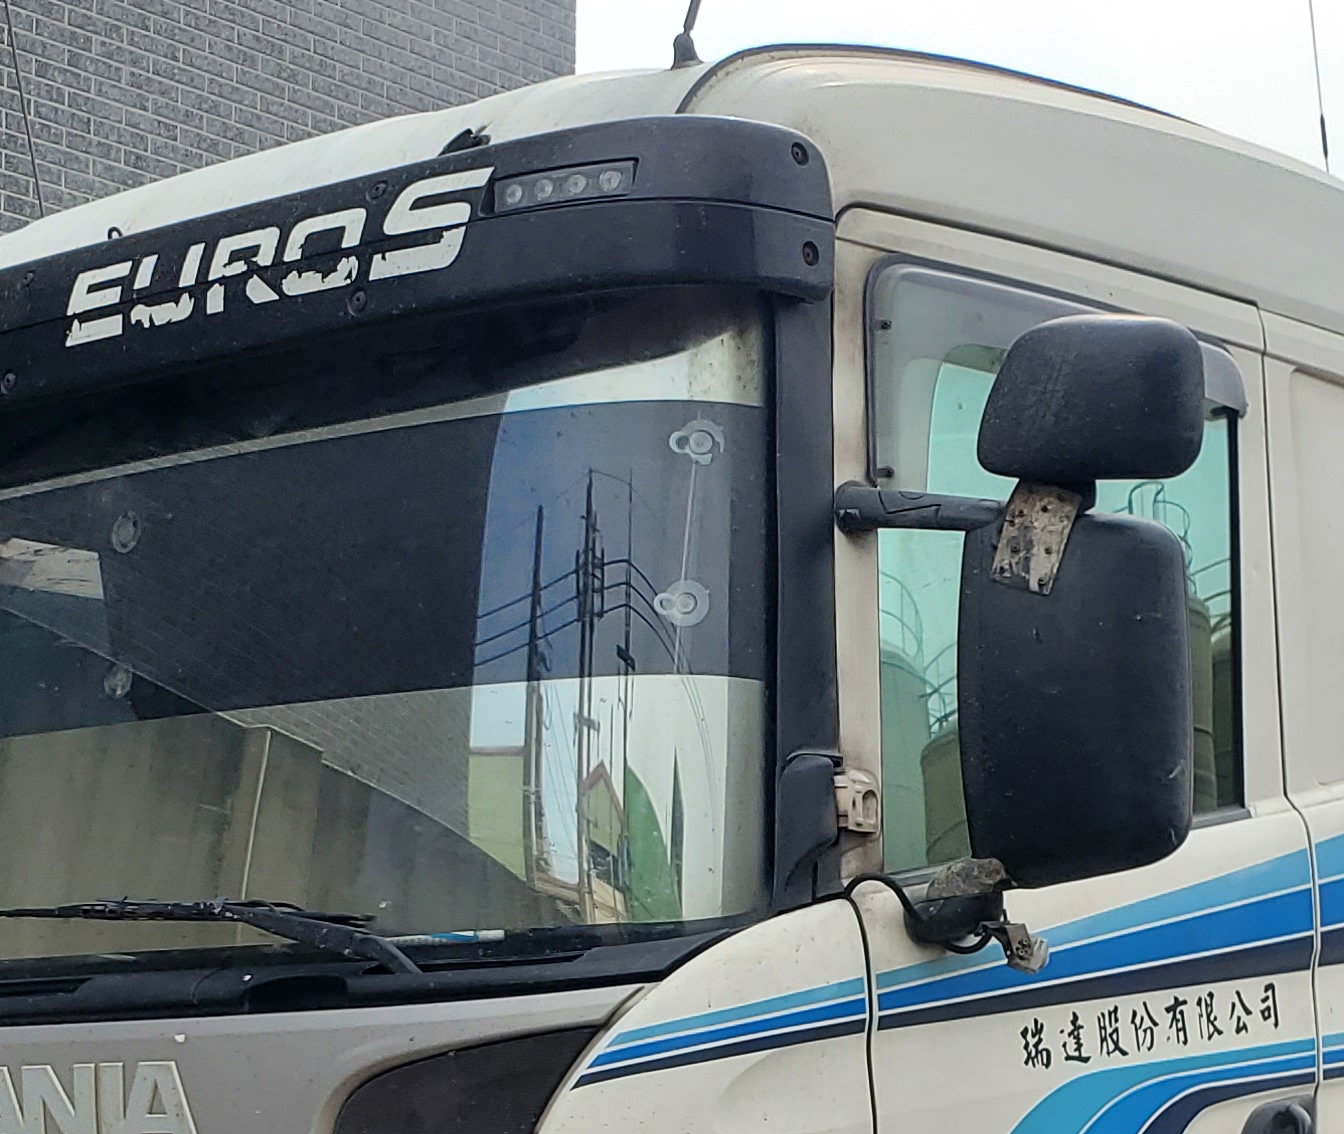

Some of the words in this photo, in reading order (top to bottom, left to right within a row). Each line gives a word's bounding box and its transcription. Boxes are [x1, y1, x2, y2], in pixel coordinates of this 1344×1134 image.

[1020, 982, 1280, 1070] 瑞達股份有限公司
